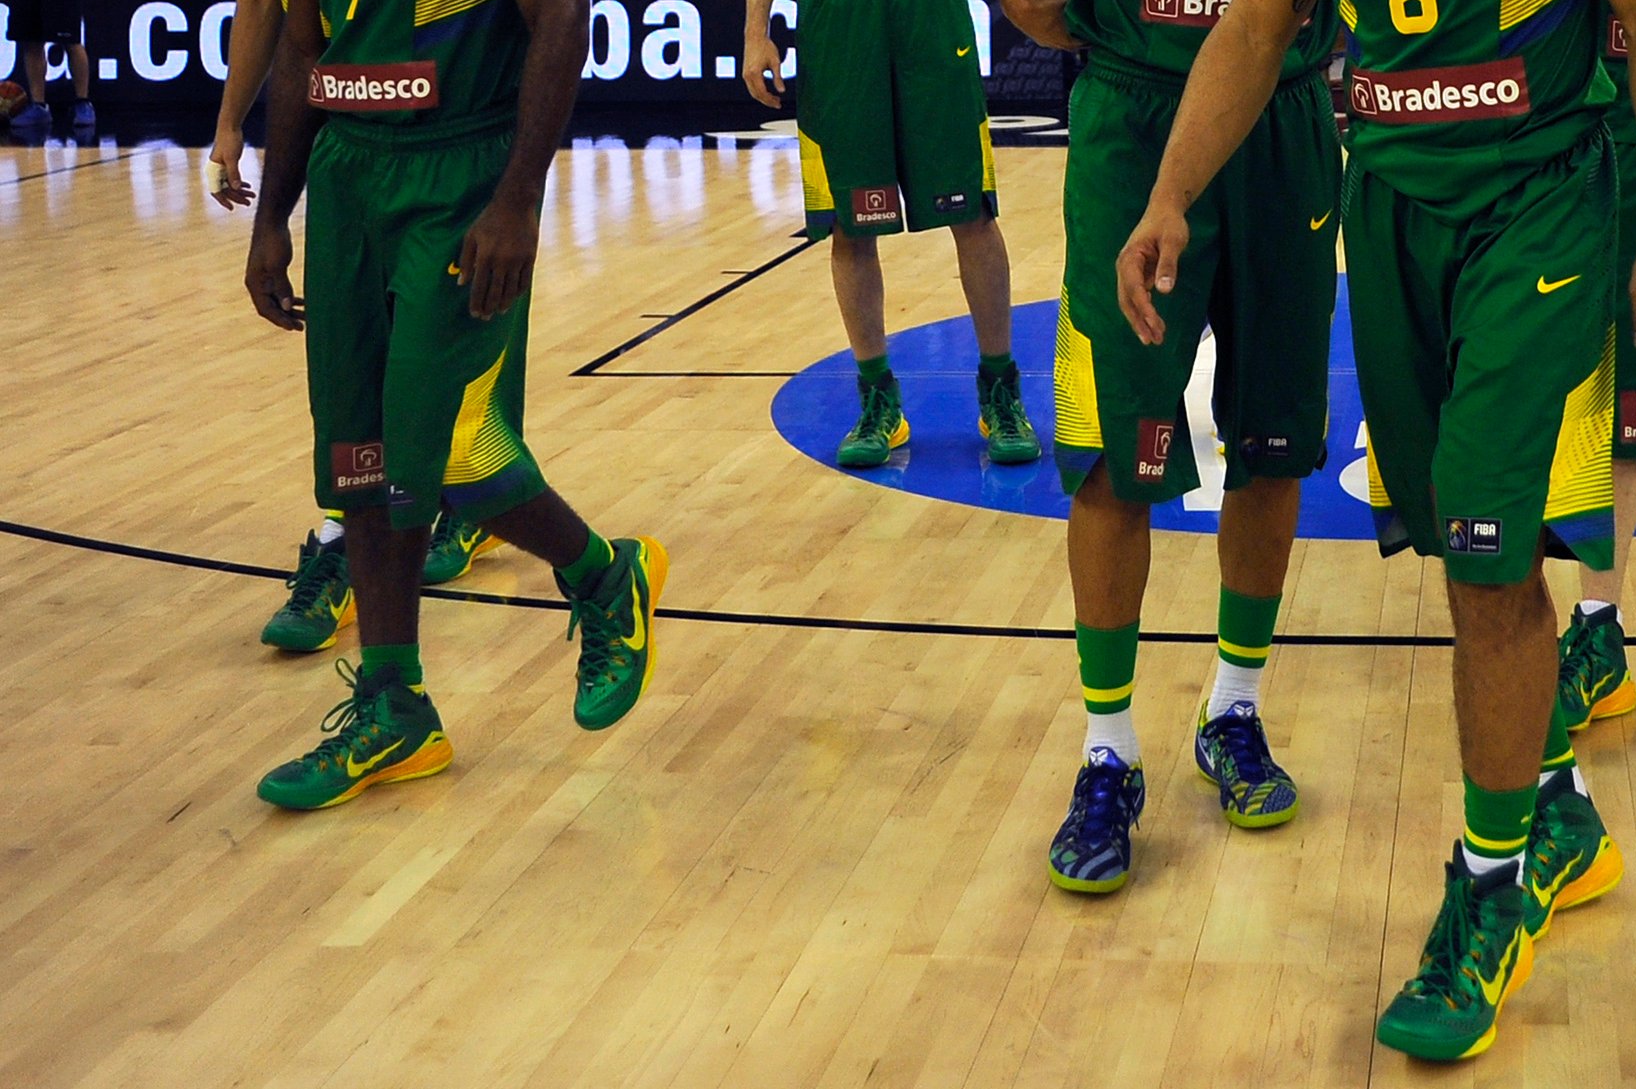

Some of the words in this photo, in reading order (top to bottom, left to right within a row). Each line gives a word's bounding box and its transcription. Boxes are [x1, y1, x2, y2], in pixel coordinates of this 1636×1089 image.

[322, 75, 431, 101] Bradesco
[1374, 78, 1520, 113] Bradesco
[856, 211, 897, 223] Bradesco
[1268, 437, 1288, 447] FIBA
[1138, 461, 1165, 476] Brad
[337, 472, 384, 488] Brades
[1473, 523, 1497, 537] FIBA
